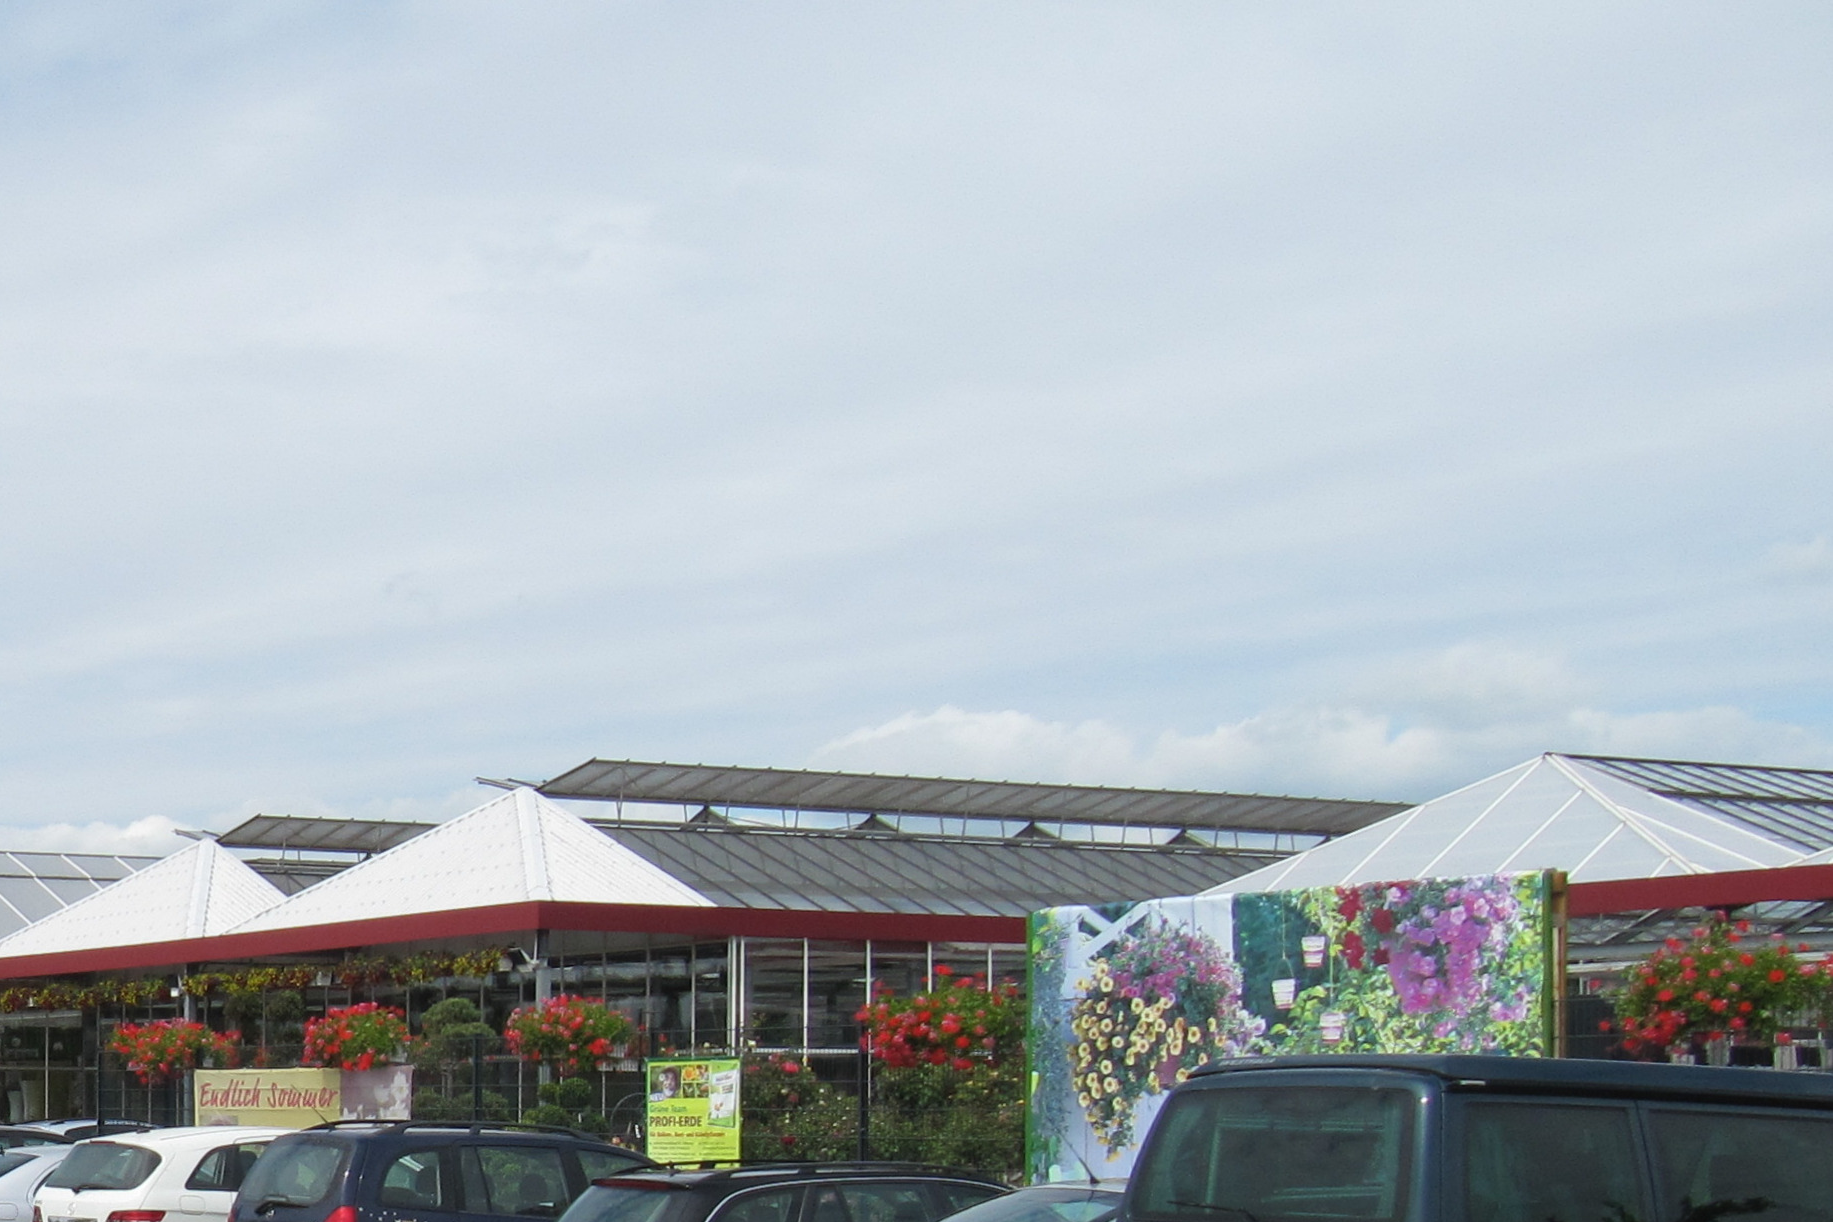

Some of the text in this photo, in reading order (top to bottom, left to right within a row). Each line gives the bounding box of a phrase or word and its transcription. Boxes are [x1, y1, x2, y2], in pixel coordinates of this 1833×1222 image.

[200, 1077, 338, 1108] Endlich Sommer
[649, 1115, 703, 1127] PROFI-ERDE
